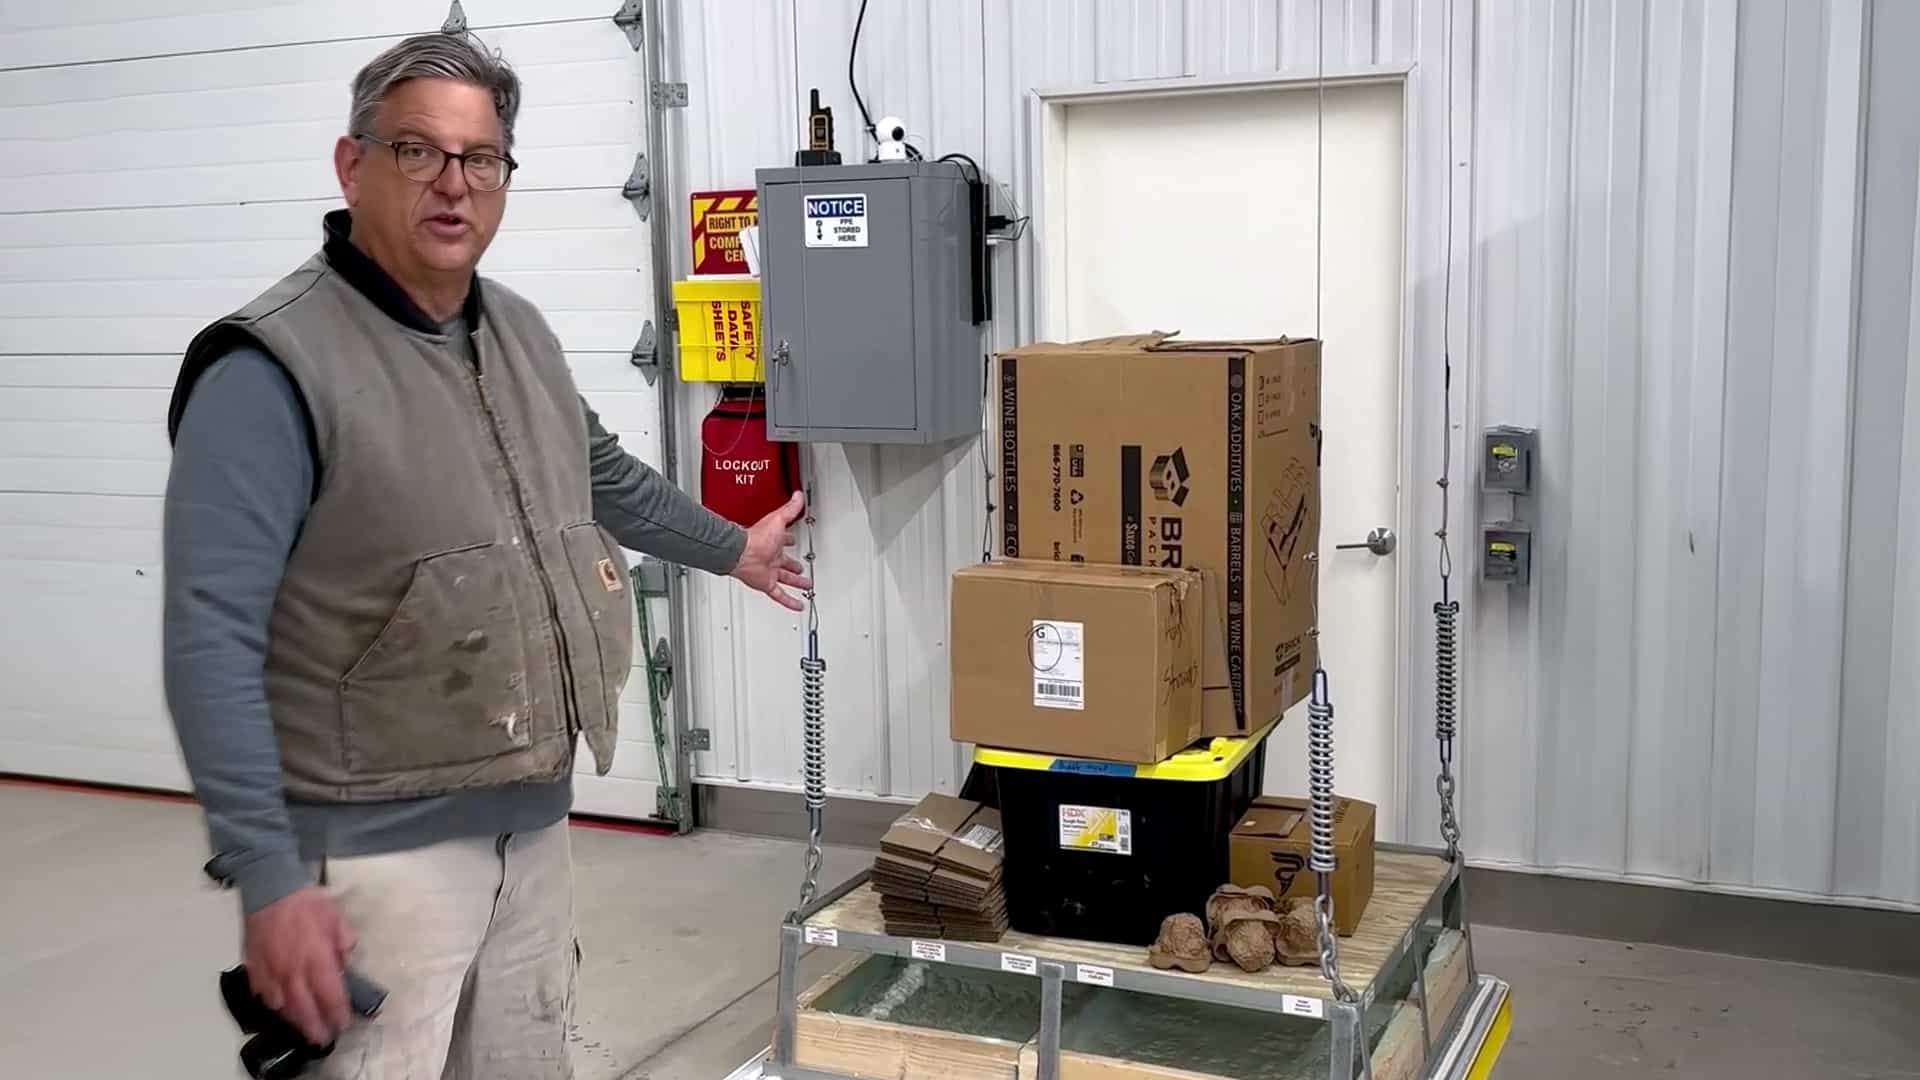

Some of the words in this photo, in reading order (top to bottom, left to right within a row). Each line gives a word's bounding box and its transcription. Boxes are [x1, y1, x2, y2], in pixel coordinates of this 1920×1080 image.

[808, 200, 864, 215] NOTICE
[708, 217, 737, 231] RIGHT
[738, 215, 751, 229] TO
[833, 226, 861, 234] STORED
[838, 234, 857, 242] HERE
[711, 301, 727, 363] SHEETS
[741, 301, 756, 362] SAFETY
[1004, 387, 1016, 425] WINE
[1231, 392, 1242, 420] OAK
[714, 459, 770, 471] LOCKOUT
[1004, 430, 1017, 492] BOTTLES
[1231, 423, 1242, 492] ADDITIVES
[735, 473, 755, 485] KIT
[1230, 528, 1242, 582] BARRELS
[1036, 626, 1046, 639] G
[1230, 618, 1241, 655] WINE
[1062, 807, 1087, 818] HDX
